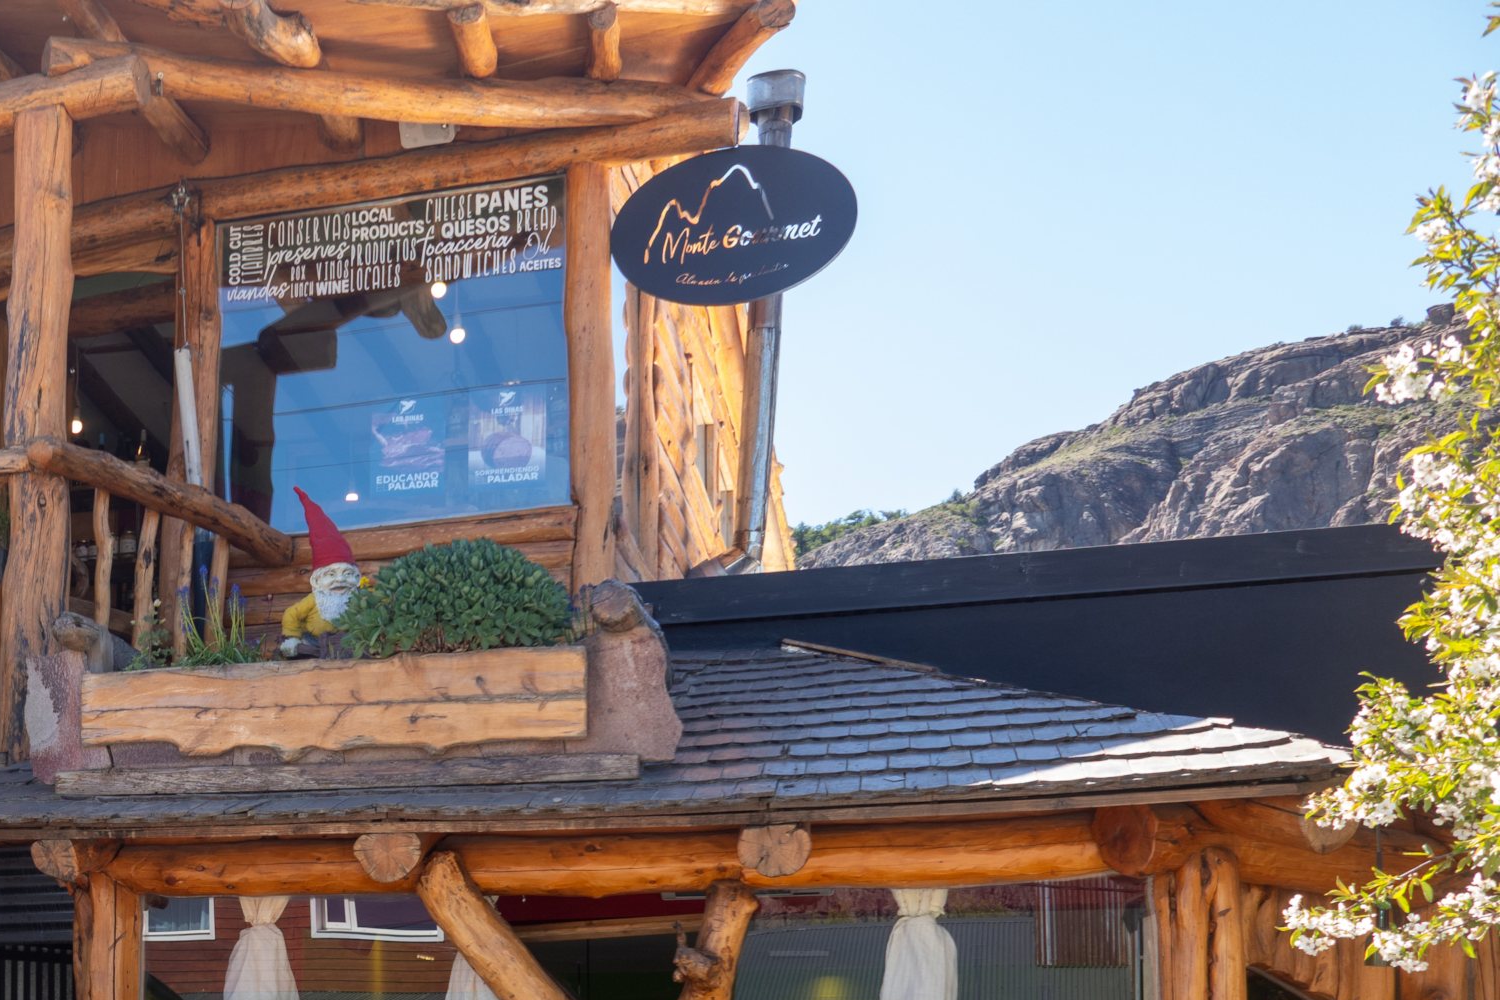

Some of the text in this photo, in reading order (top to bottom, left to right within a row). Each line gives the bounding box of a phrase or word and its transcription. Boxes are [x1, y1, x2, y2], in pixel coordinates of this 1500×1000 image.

[425, 194, 473, 224] CHEESE
[475, 185, 548, 216] PANES
[268, 213, 351, 249] CONSERVAS
[352, 208, 395, 226] LOCAL
[352, 220, 424, 242] PRODUCTS
[441, 215, 511, 239] QUESOS
[516, 206, 557, 234] BREAD
[350, 237, 417, 268] PRODUCTOS
[416, 225, 513, 268] focacceria
[661, 214, 823, 265] Monte Gourmet
[229, 225, 242, 286] COLD CUT
[263, 242, 350, 281] preserves
[316, 259, 350, 281] VINOS
[425, 248, 517, 283] SANDWICHES
[519, 257, 562, 272] ACEITES
[227, 264, 291, 303] viandas
[290, 281, 314, 298] LUNCH
[315, 279, 349, 297] WINE
[350, 263, 401, 293] LOCALES
[376, 471, 440, 485] EDUCANDO
[387, 479, 439, 491] PALADAR
[487, 471, 539, 484] PALADAR
